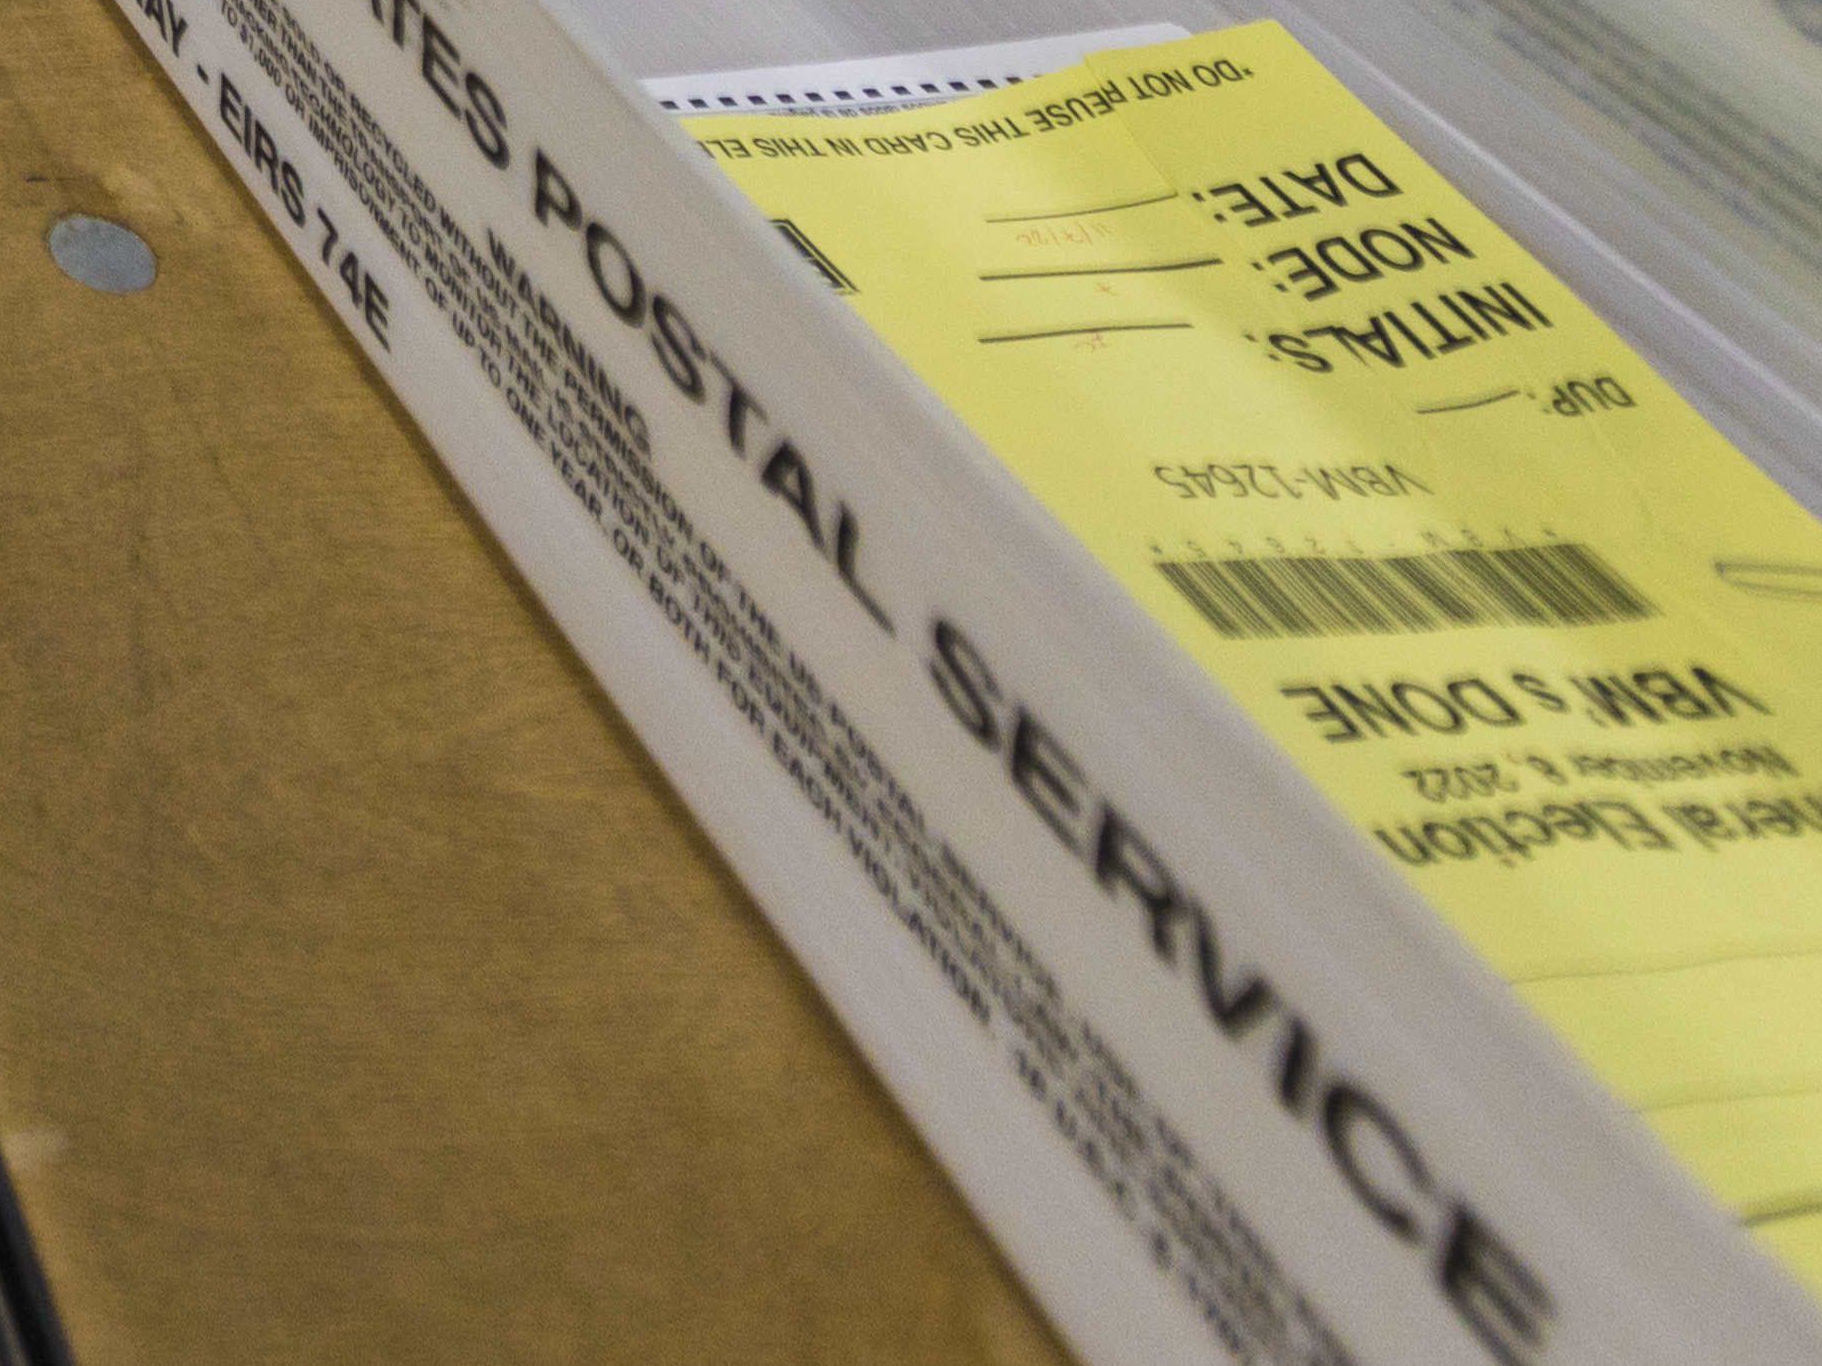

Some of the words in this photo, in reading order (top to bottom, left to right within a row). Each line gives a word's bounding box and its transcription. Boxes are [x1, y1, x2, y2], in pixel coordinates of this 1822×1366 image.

[280, 22, 315, 87] THAN
[1124, 66, 1190, 103] NOT
[753, 135, 821, 161] THIS
[827, 136, 856, 160] IN
[861, 126, 952, 158] CARD
[957, 113, 1025, 151] THIS
[219, 70, 306, 229] EIRS
[318, 206, 391, 353] 74E
[1191, 151, 1401, 228] DATE:
[1250, 215, 1474, 301] NODE:
[487, 227, 652, 457] WARNING
[1243, 280, 1554, 376] INITIALS:
[1526, 374, 1636, 420] DUP:
[1153, 461, 1436, 502] VBM-12645
[1278, 679, 1529, 745] DONE
[1511, 663, 1775, 729] VBM's
[534, 146, 898, 639] POSTAL
[928, 614, 1559, 1366] SERVICE
[1399, 762, 1518, 805] 2022
[1372, 797, 1681, 869] Election
